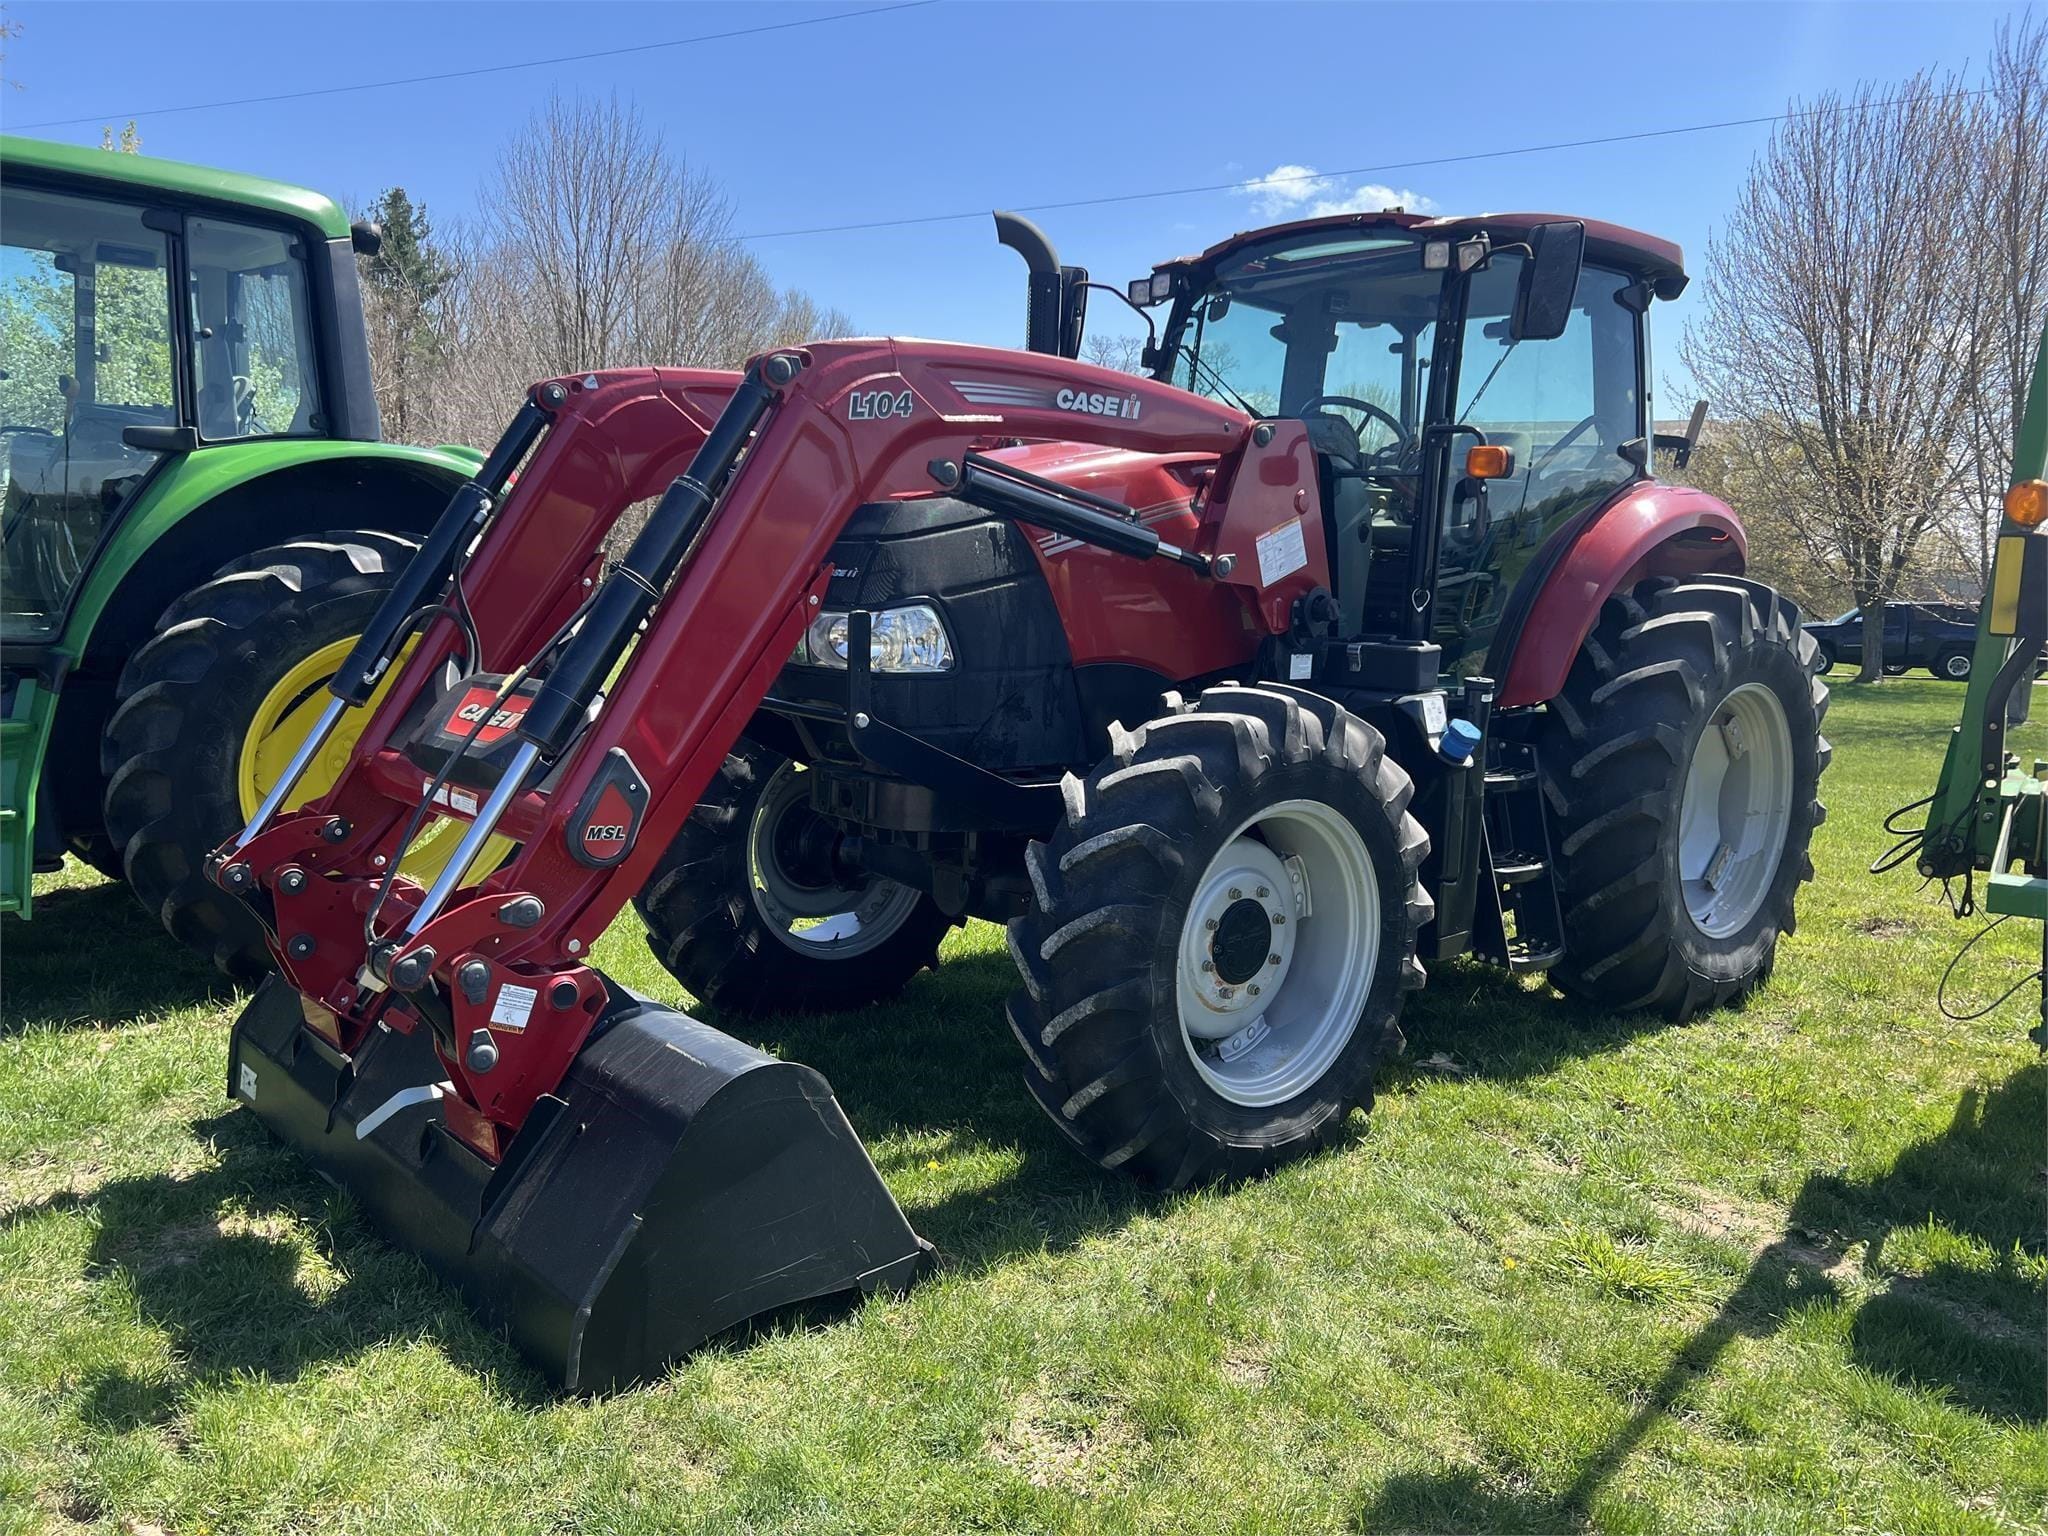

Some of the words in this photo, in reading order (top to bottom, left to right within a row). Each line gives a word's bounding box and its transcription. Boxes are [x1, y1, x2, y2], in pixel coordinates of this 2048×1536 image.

[849, 390, 912, 419] L104
[1056, 388, 1120, 417] CASE
[585, 825, 626, 841] MSL
